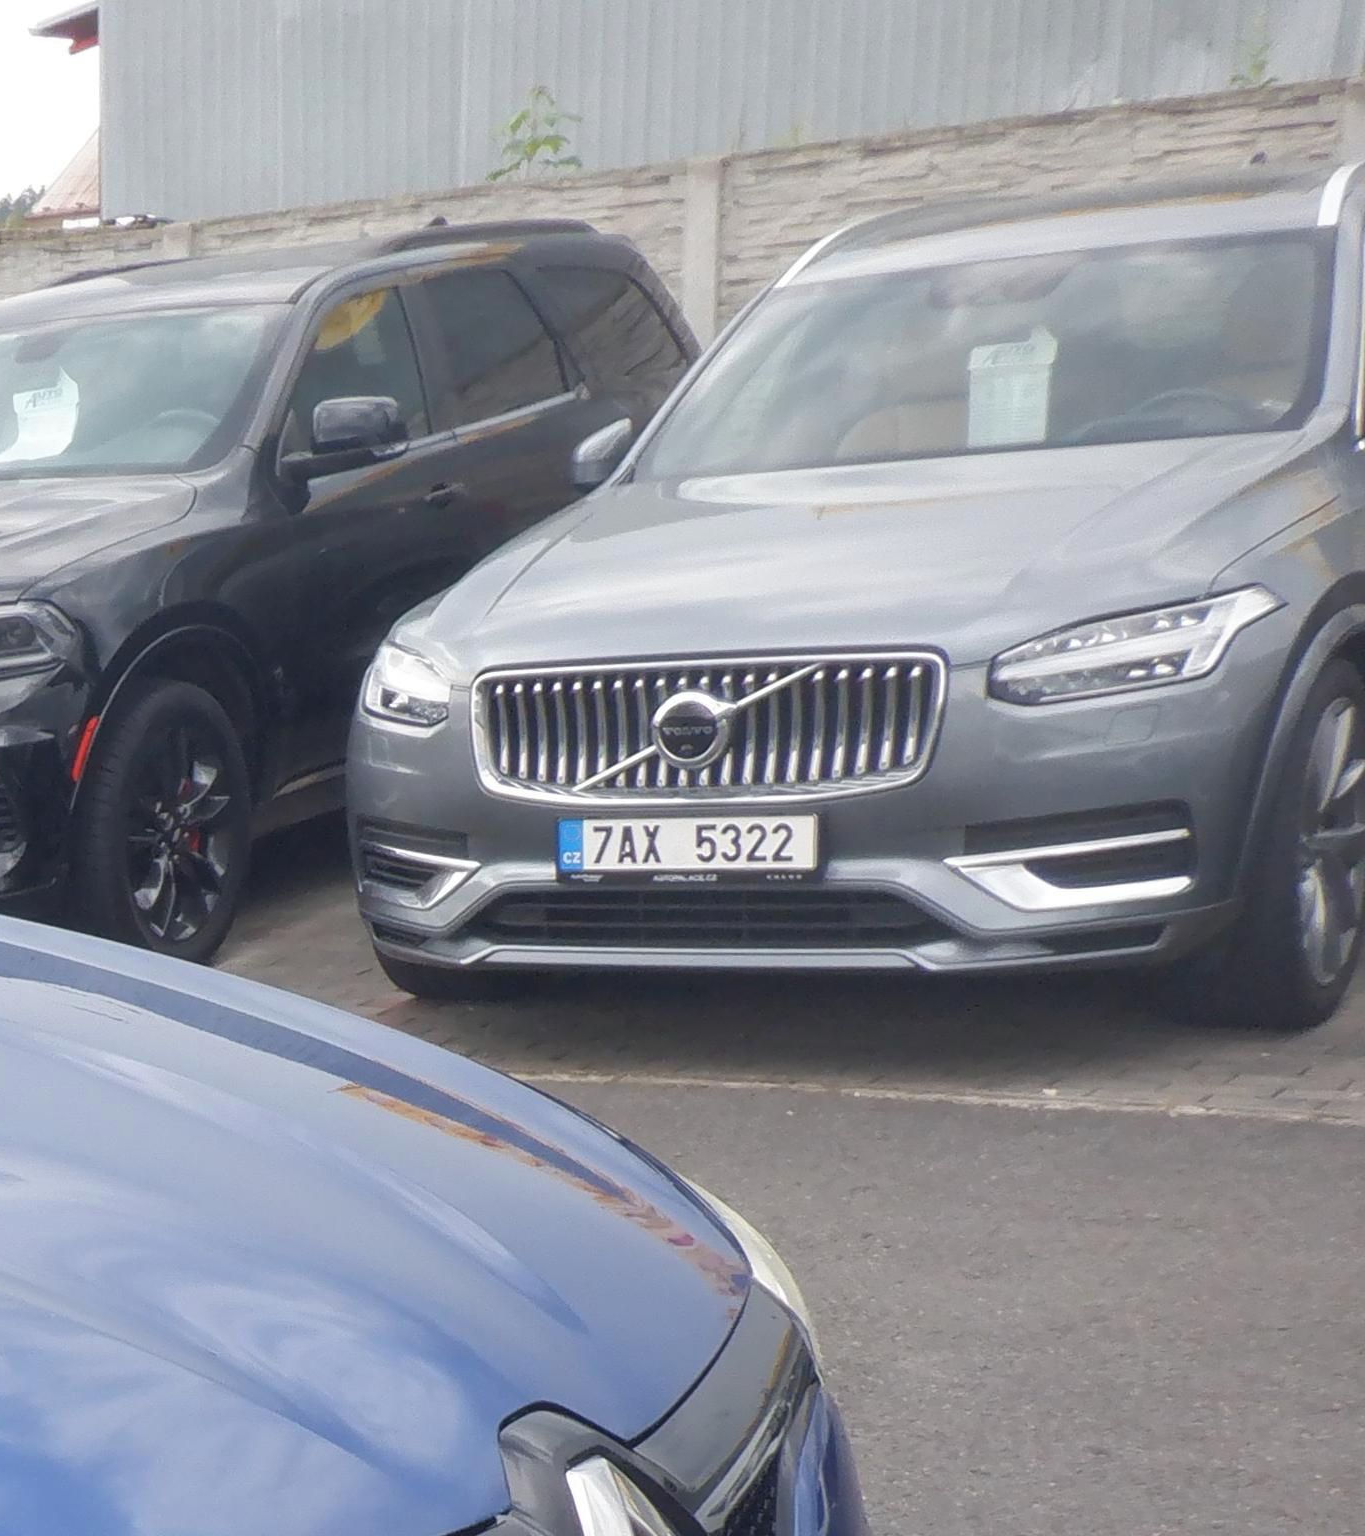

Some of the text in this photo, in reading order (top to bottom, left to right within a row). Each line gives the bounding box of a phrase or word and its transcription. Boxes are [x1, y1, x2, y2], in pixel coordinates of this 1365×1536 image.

[662, 726, 713, 736] VOLVO
[592, 822, 794, 864] 7AX 5322
[562, 852, 582, 865] CZ
